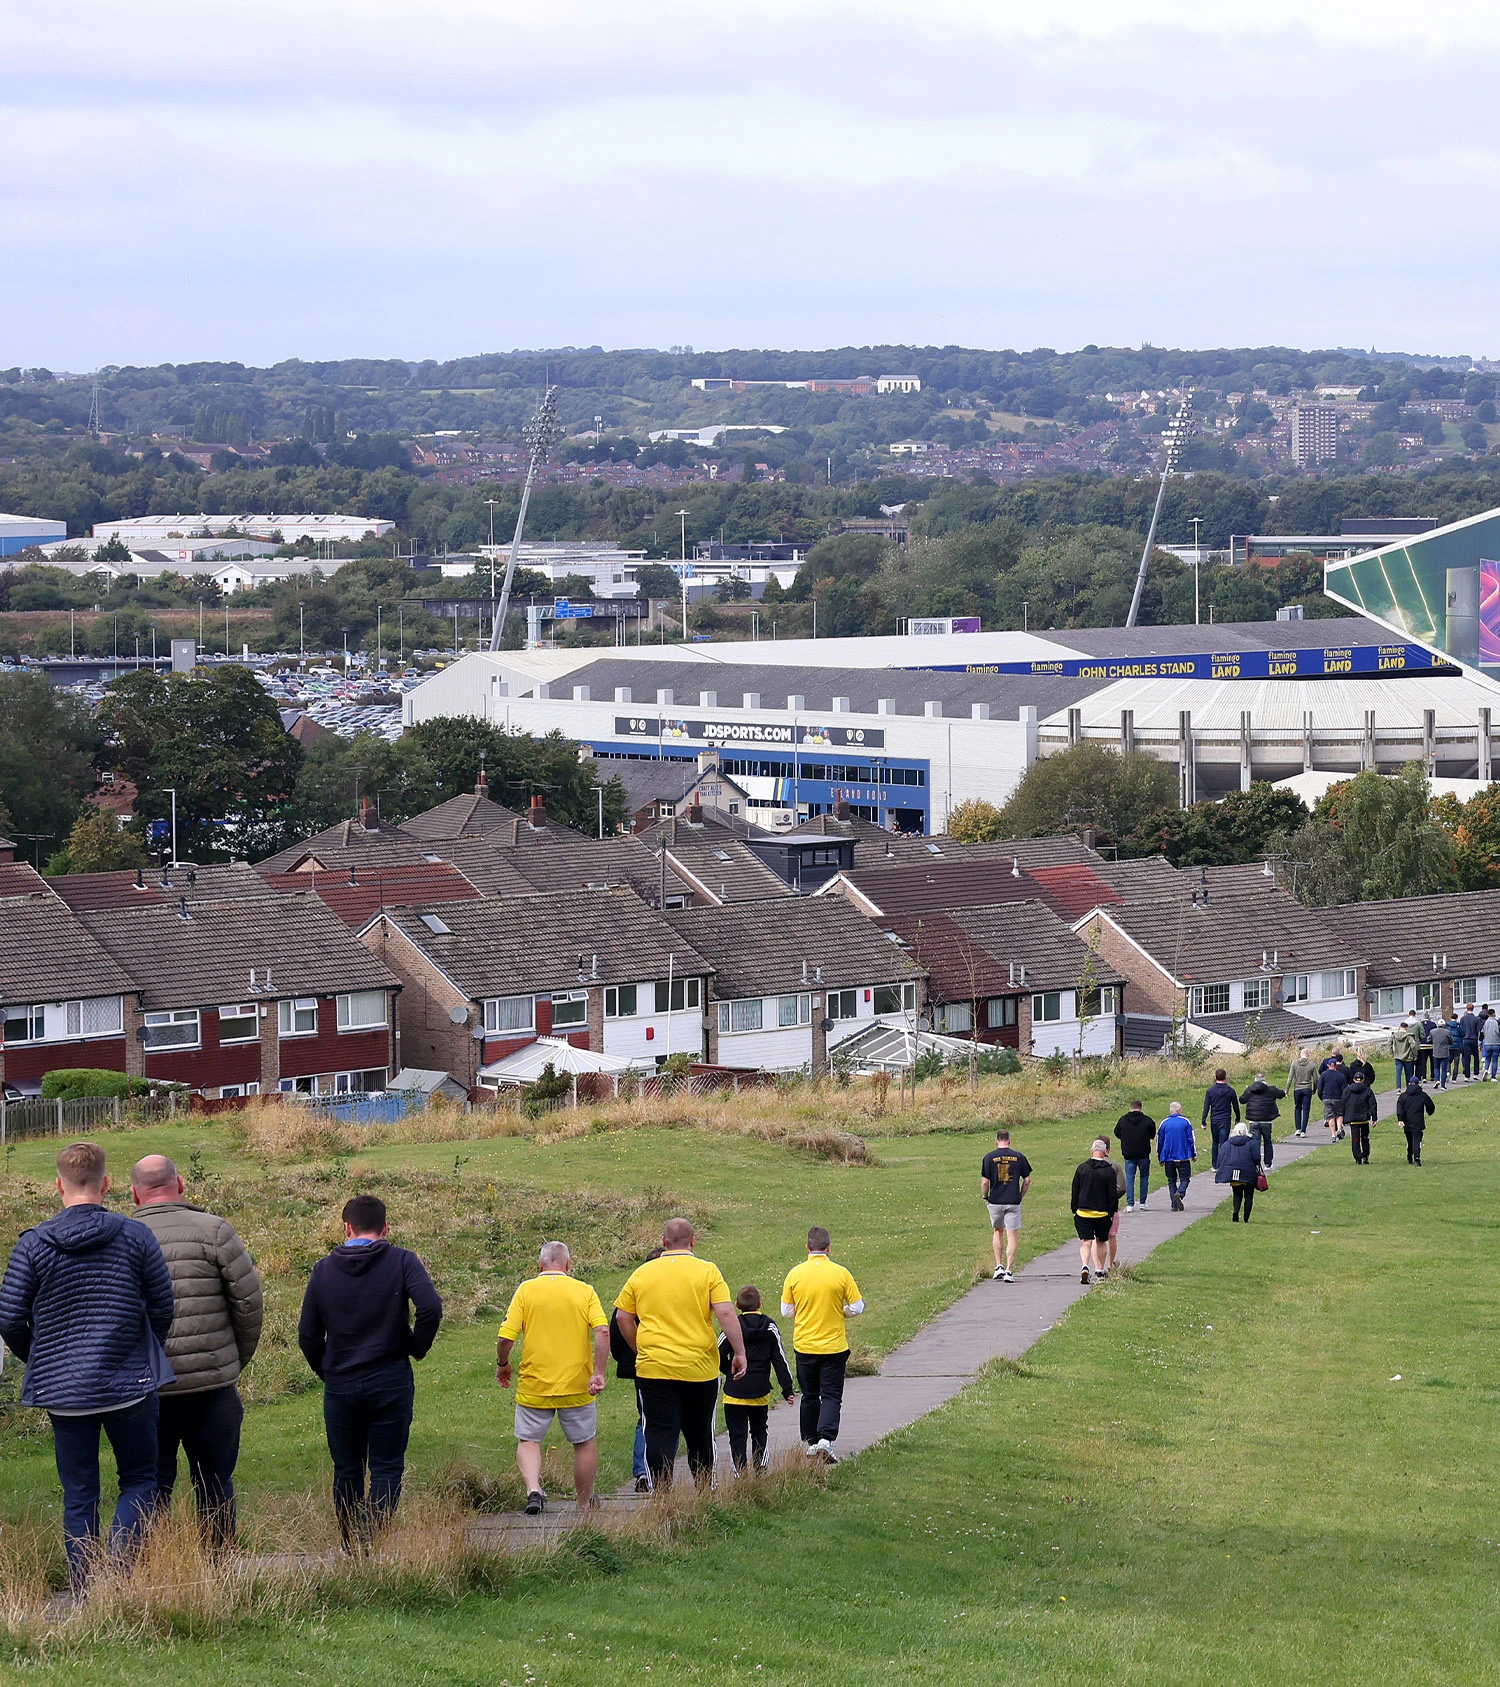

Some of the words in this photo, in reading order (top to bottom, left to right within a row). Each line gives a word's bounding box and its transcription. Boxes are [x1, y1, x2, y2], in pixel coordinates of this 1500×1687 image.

[1268, 650, 1297, 662] flamingo
[1324, 648, 1352, 660] flamingo
[1378, 645, 1406, 657] flamingo
[1211, 653, 1241, 664] flamingo
[1378, 656, 1406, 669] LAND
[1031, 661, 1064, 673] flamingo
[1079, 666, 1107, 678] JOHN
[1109, 663, 1158, 678] CHARLES
[1160, 661, 1195, 675] STAND
[1211, 665, 1241, 679] LAND
[1268, 662, 1297, 675] LAND
[1324, 660, 1352, 673] LAND
[702, 723, 792, 742] JDSPORTS.COM
[831, 787, 861, 800] ELAND
